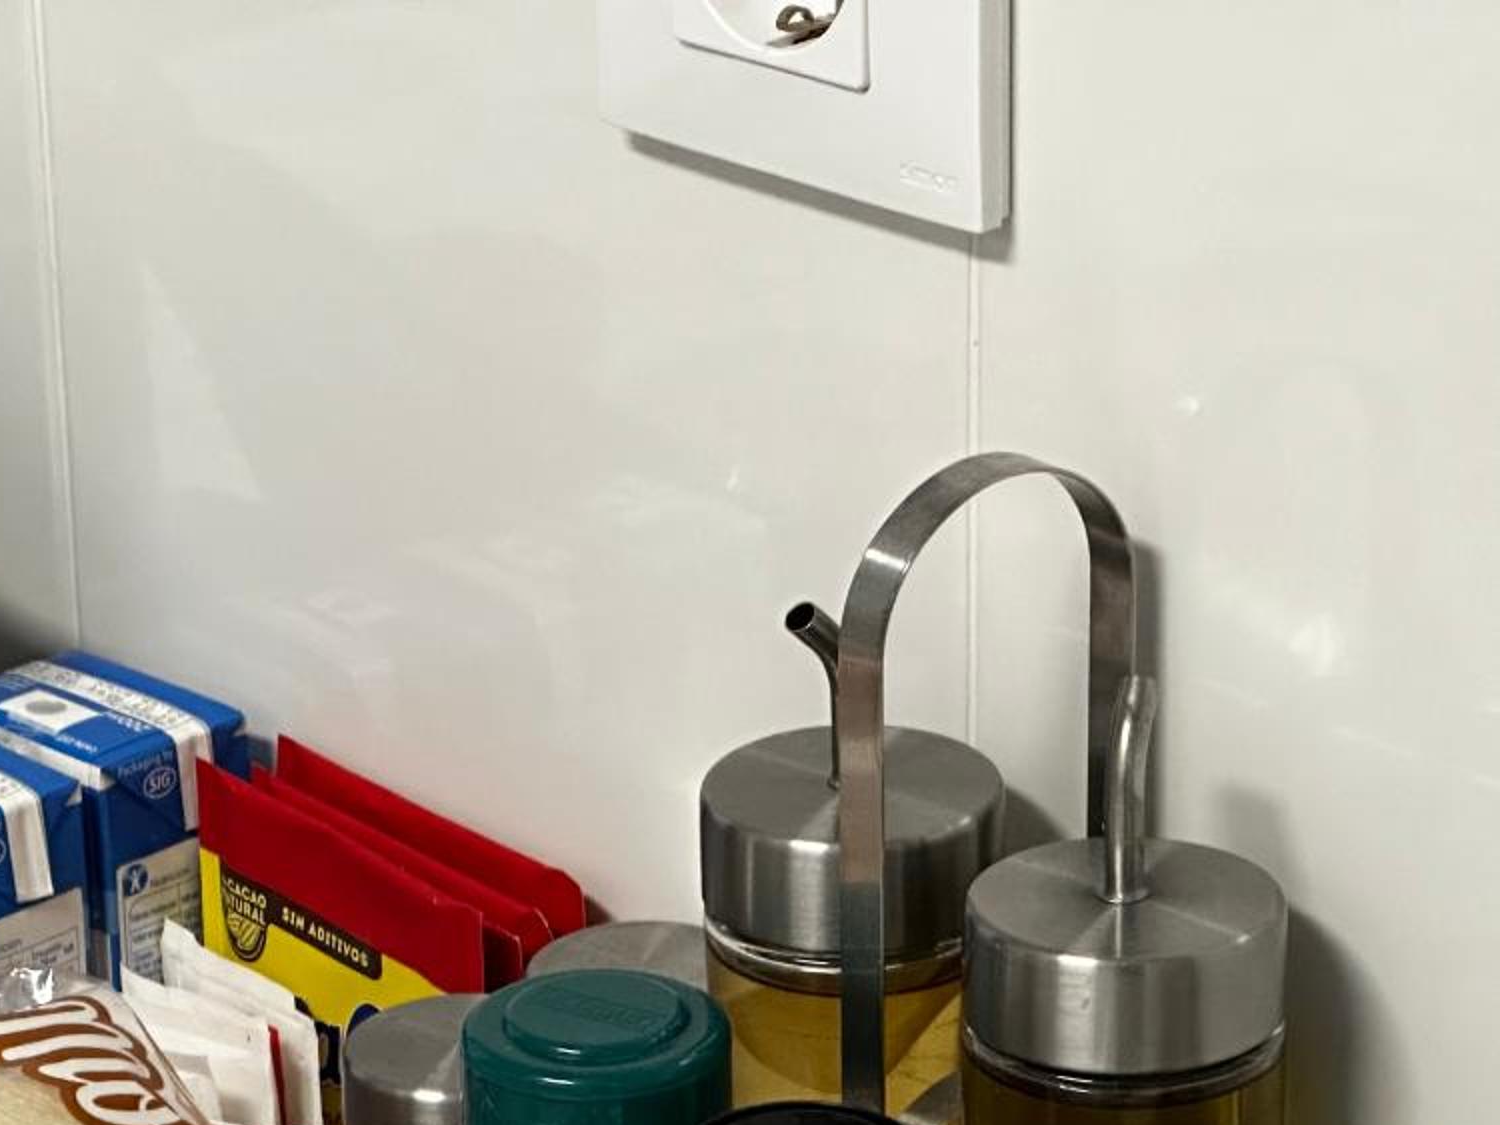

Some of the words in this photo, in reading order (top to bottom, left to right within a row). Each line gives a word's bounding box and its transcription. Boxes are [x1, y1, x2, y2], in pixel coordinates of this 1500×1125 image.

[227, 897, 267, 926] TURAL
[281, 906, 306, 930] SIN
[307, 921, 370, 968] ADITIVOS
